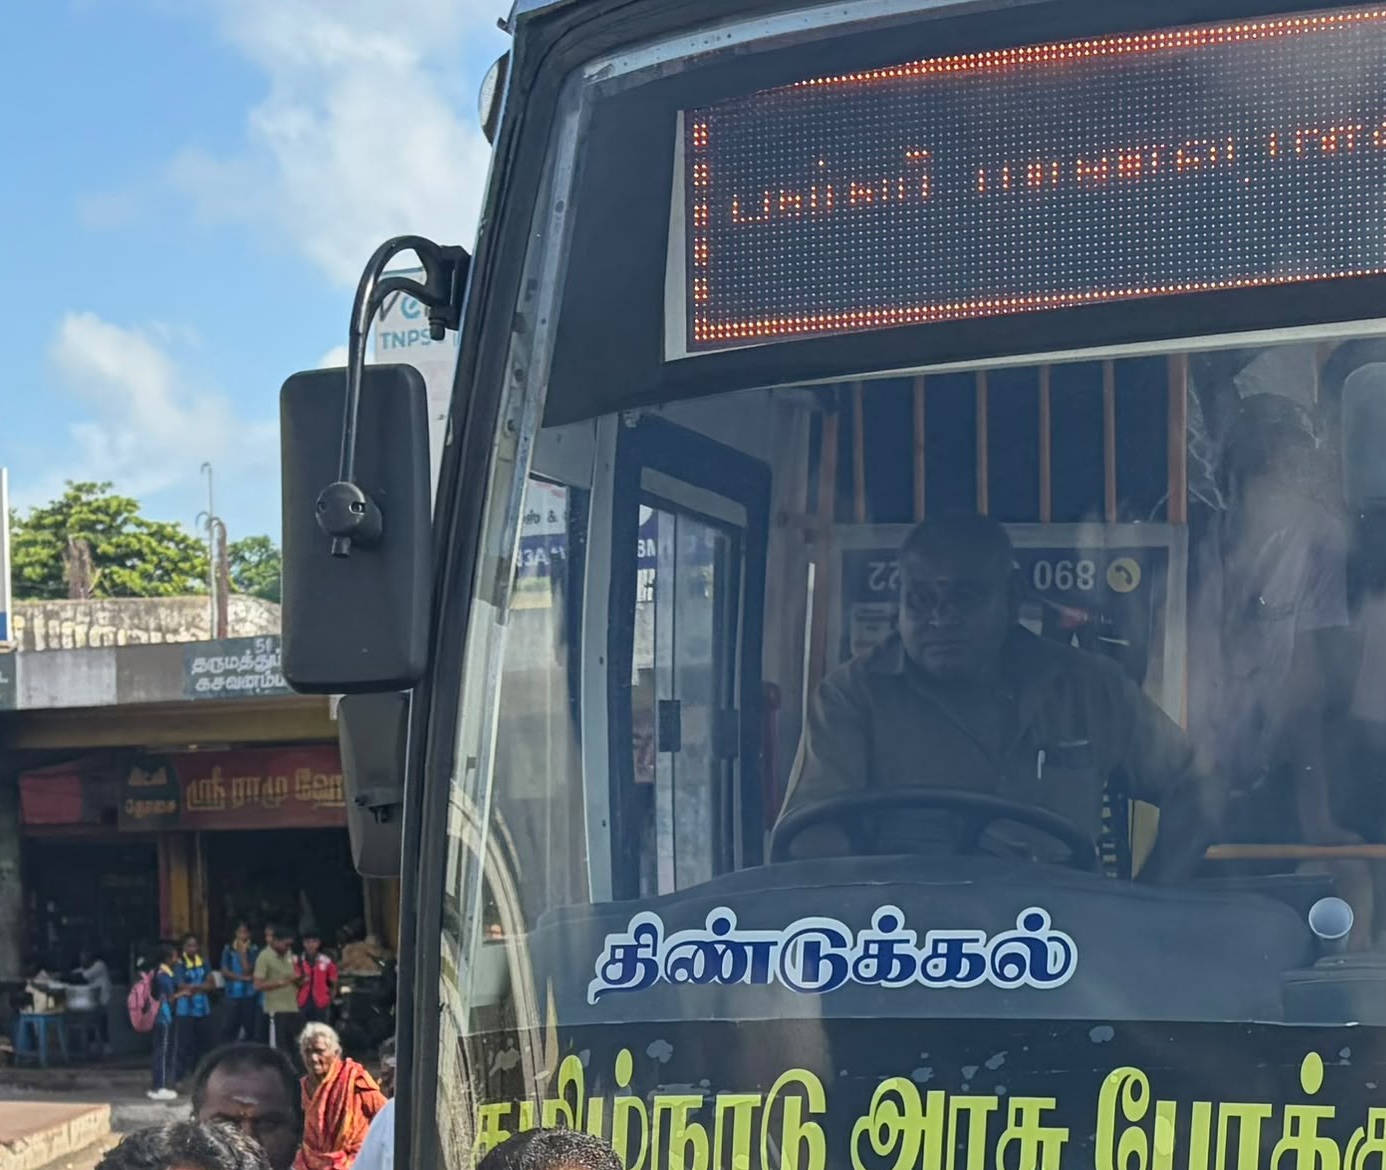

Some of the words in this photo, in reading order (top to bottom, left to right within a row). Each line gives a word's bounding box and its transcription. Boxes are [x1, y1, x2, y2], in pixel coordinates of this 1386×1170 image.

[381, 329, 444, 350] TNPS
[195, 671, 287, 692] கசவனம்ப
[589, 909, 1076, 1000] திண்டுக்கல்
